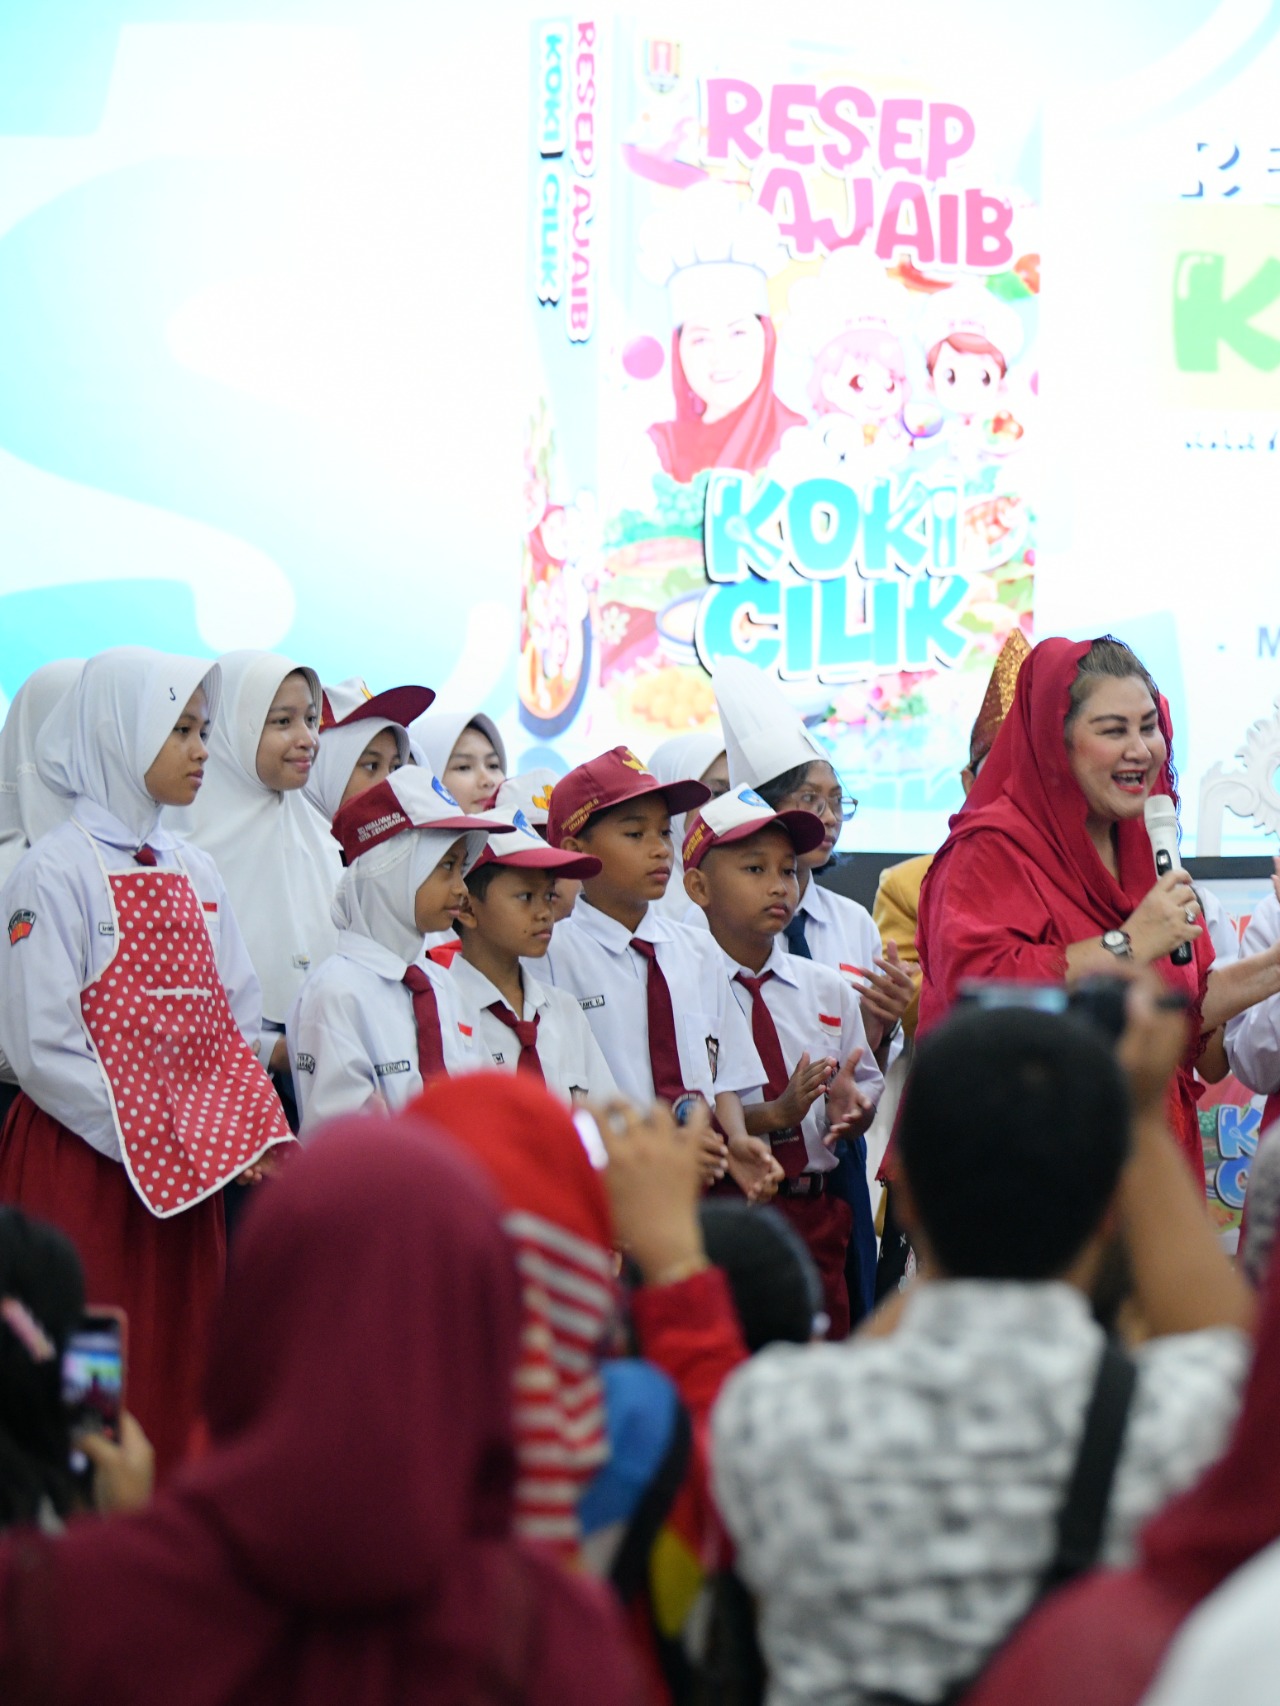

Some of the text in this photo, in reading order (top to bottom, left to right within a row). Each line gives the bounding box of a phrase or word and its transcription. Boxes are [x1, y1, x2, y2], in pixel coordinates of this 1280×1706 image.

[540, 32, 563, 289] KOKI CILIK
[570, 20, 596, 331] RESEP AJAIB
[705, 77, 976, 181] RESEP
[757, 167, 1015, 268] AJAIB
[705, 471, 962, 579] KOKI
[702, 574, 970, 672] CILIK
